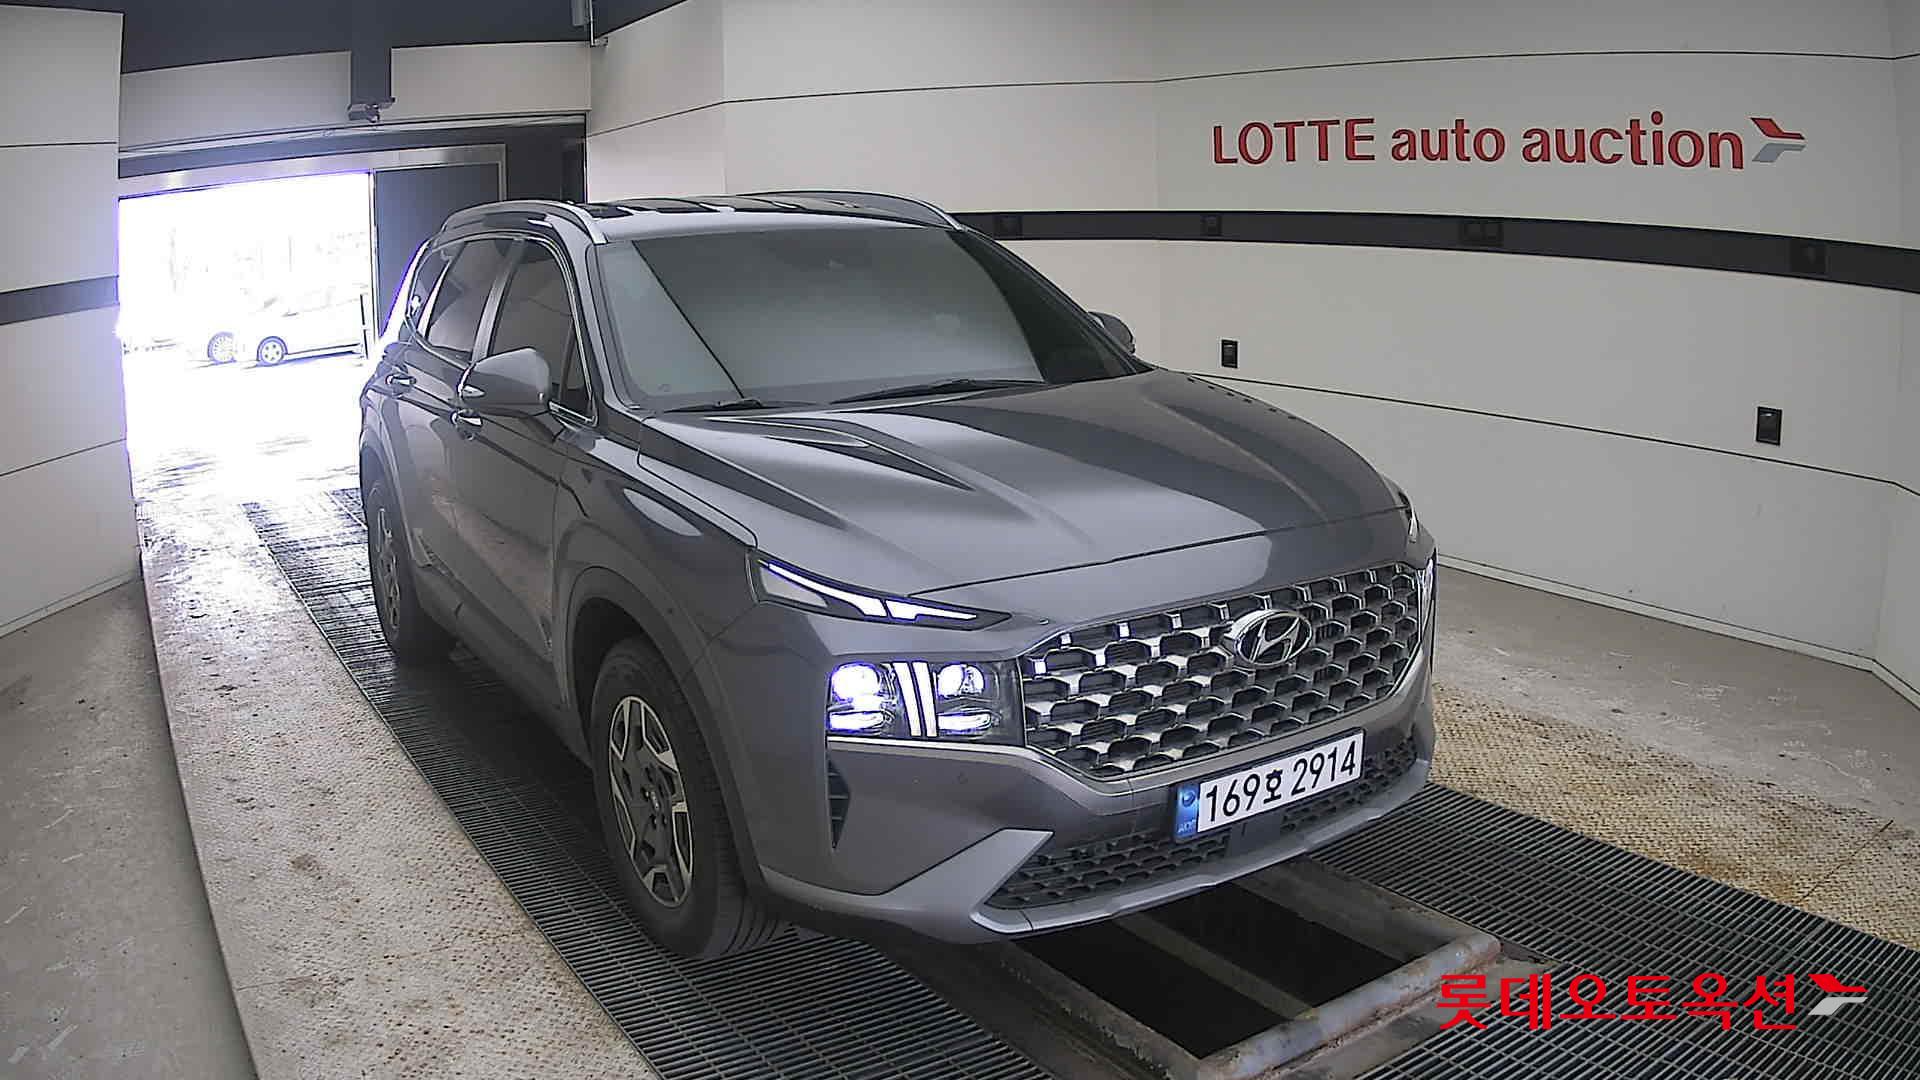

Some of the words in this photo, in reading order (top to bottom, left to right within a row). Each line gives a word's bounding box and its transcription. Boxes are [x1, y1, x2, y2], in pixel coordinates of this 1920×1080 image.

[1212, 117, 1376, 165] LOTTE
[1391, 118, 1507, 163] auto
[1522, 110, 1745, 170] auction
[1206, 769, 1283, 822] 169호
[1291, 741, 1356, 796] 2914
